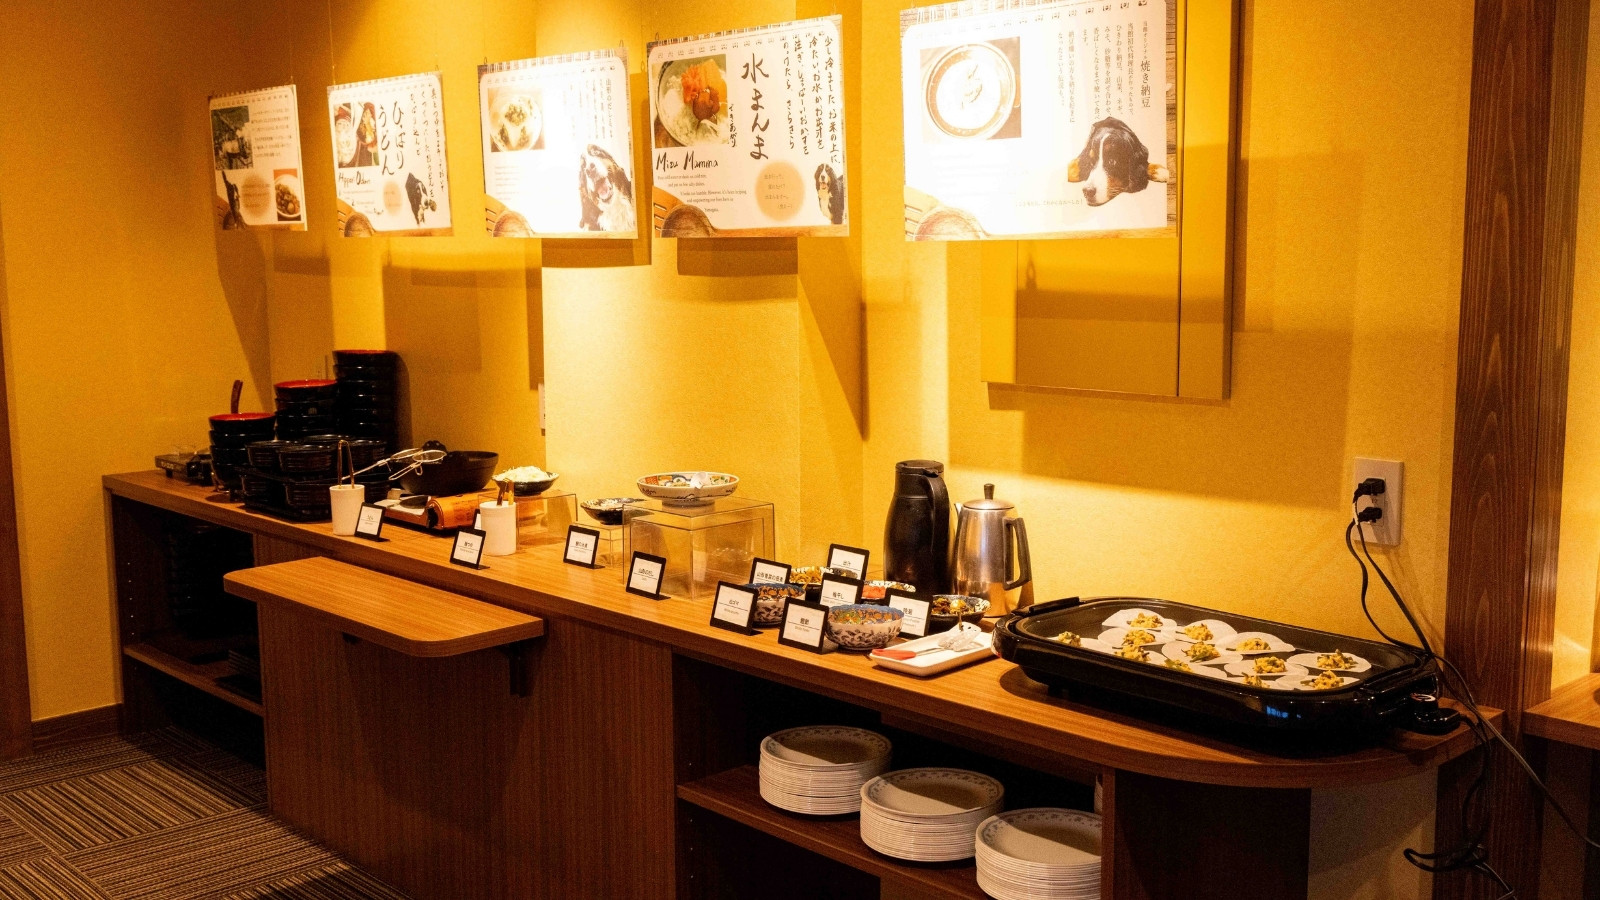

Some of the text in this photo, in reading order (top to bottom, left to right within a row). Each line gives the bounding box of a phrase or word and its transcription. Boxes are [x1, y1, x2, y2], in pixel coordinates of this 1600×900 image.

[741, 52, 770, 160] 水まんま
[1140, 60, 1151, 108] 焼き納豆
[378, 104, 395, 176] うどん
